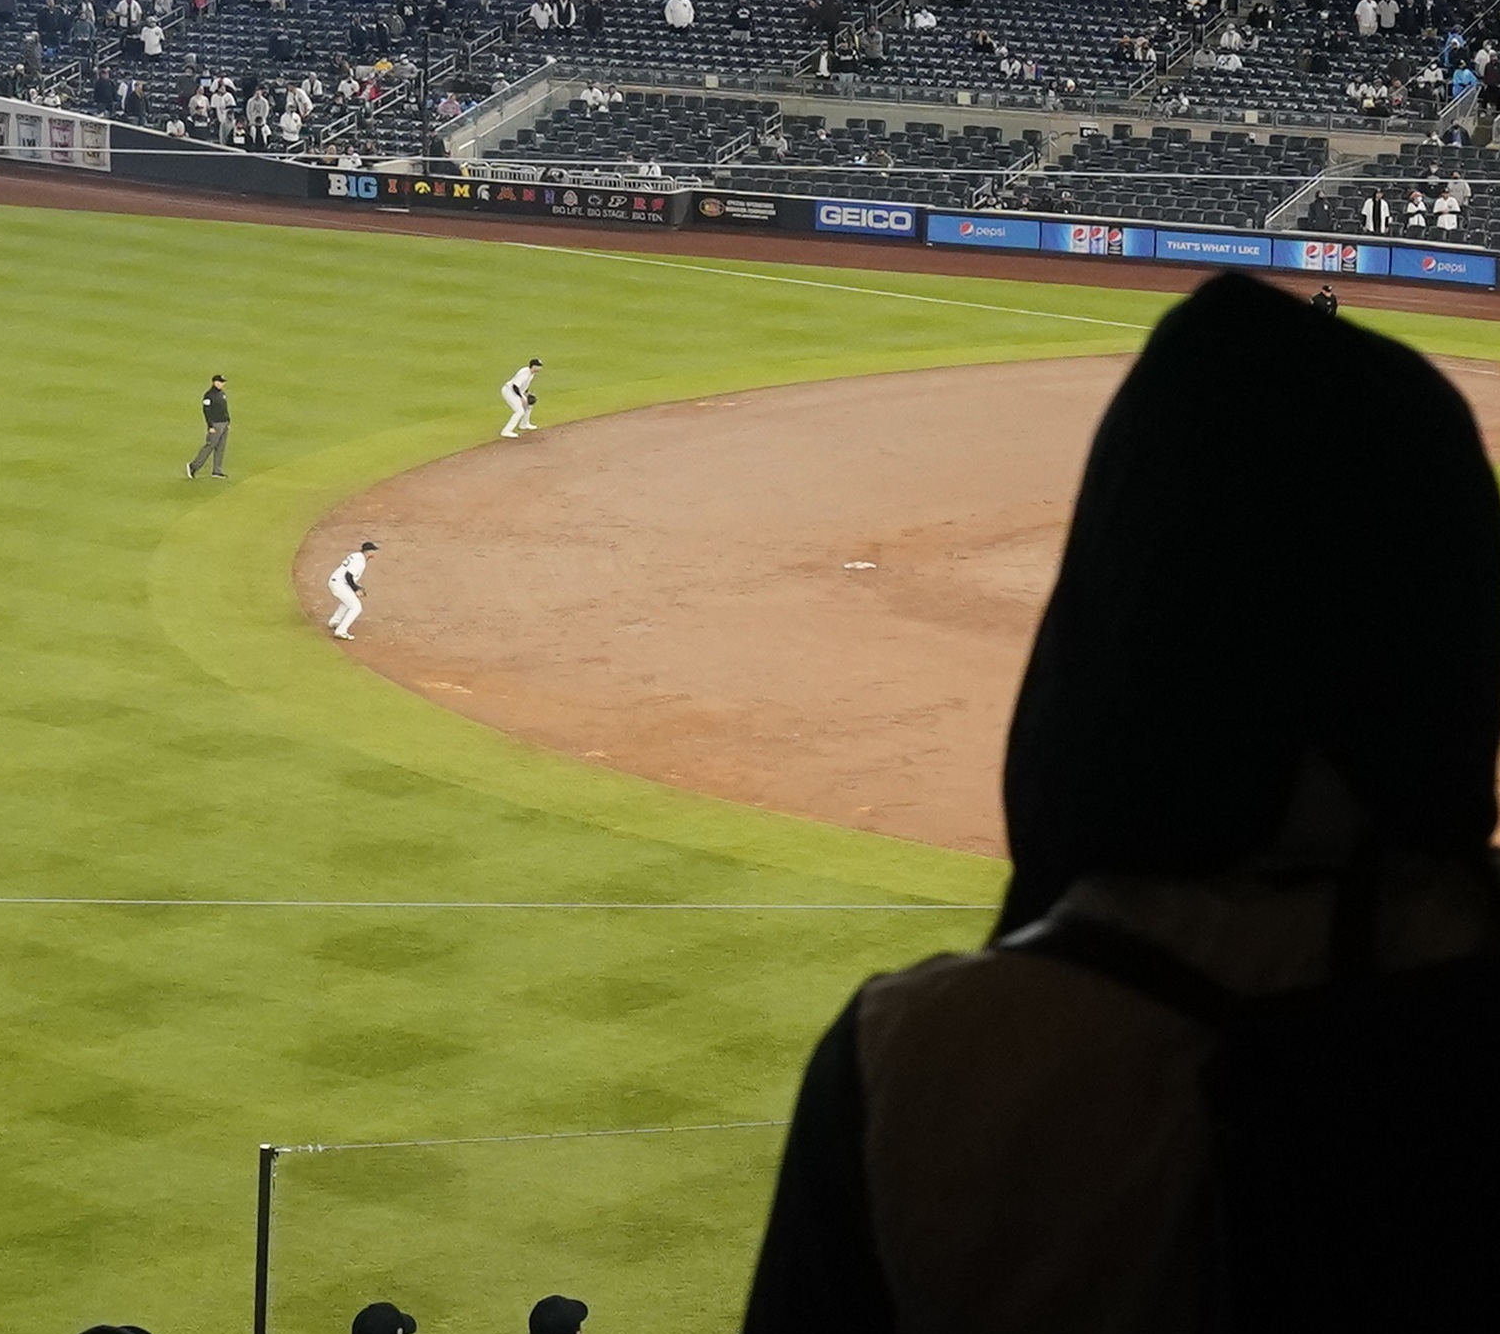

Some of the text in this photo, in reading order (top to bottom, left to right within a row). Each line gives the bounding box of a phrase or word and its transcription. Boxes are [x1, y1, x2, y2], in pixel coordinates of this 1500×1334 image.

[819, 205, 912, 230] GEICO
[975, 224, 1006, 240] pepsi
[1166, 240, 1201, 251] THAT'S
[1201, 243, 1230, 253] WHAT
[1238, 245, 1261, 256] LIKE
[1436, 259, 1467, 274] pepsi
